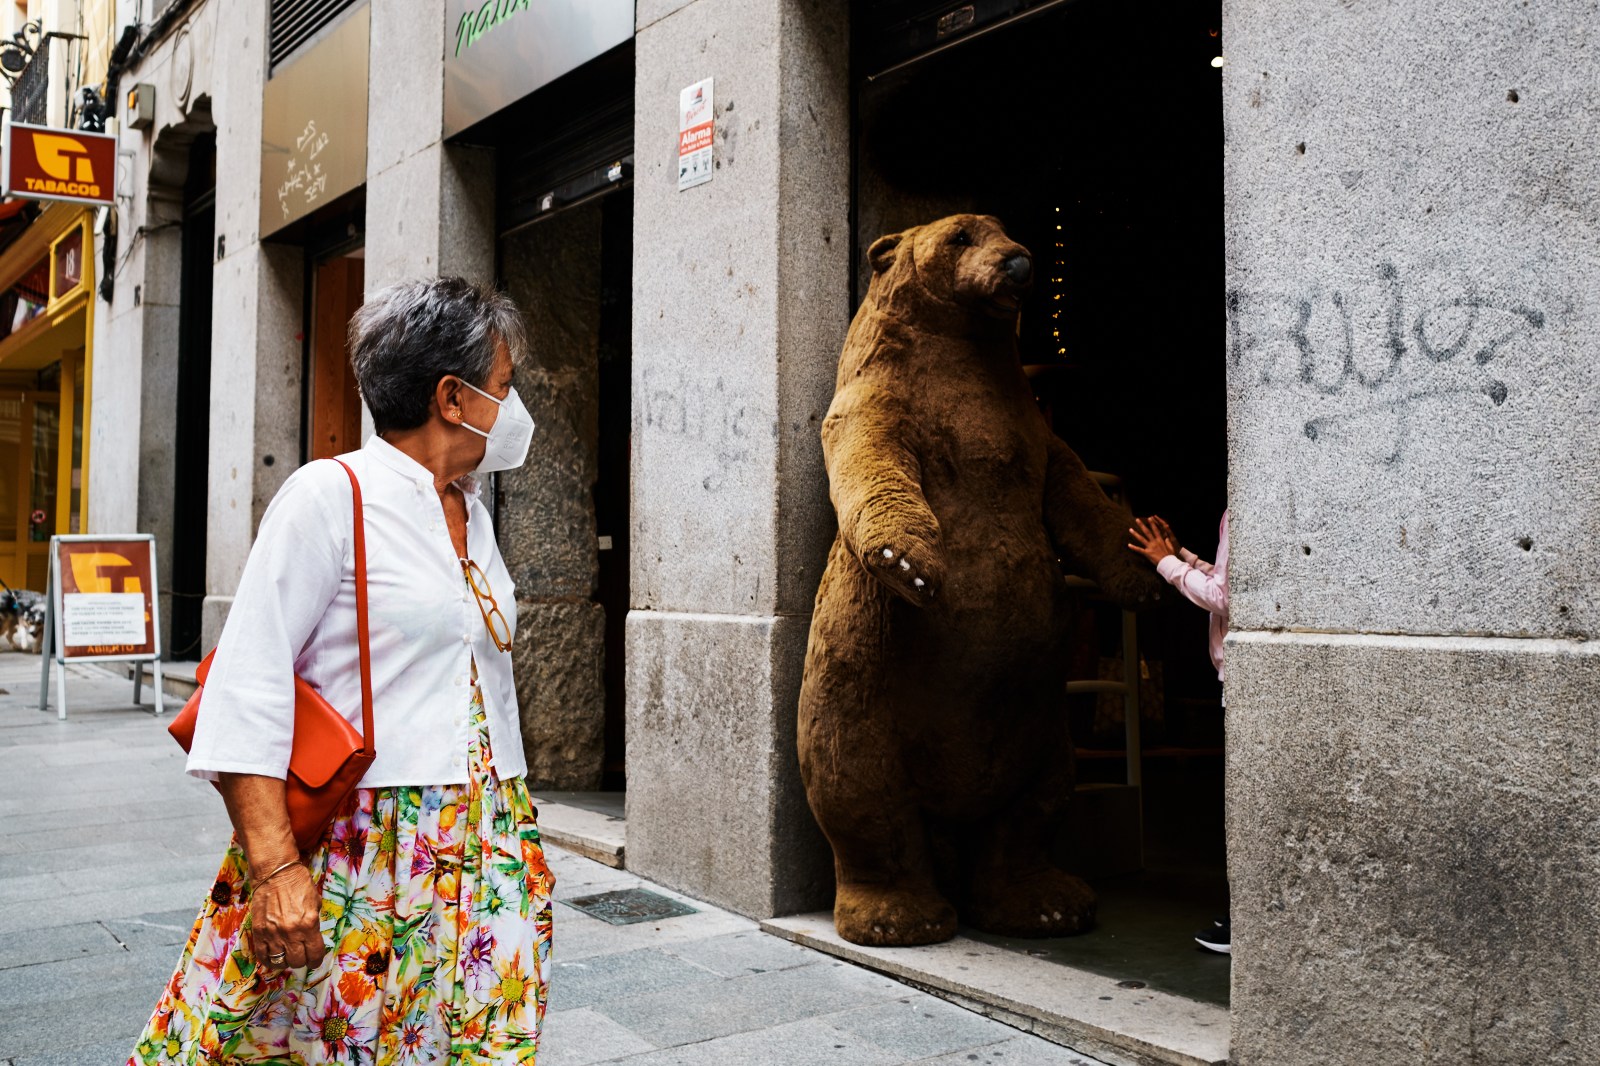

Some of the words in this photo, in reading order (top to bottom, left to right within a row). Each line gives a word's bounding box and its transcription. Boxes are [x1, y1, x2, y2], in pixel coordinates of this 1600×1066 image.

[681, 126, 711, 147] Alarma
[25, 178, 100, 197] TABACOS
[65, 248, 75, 279] 18
